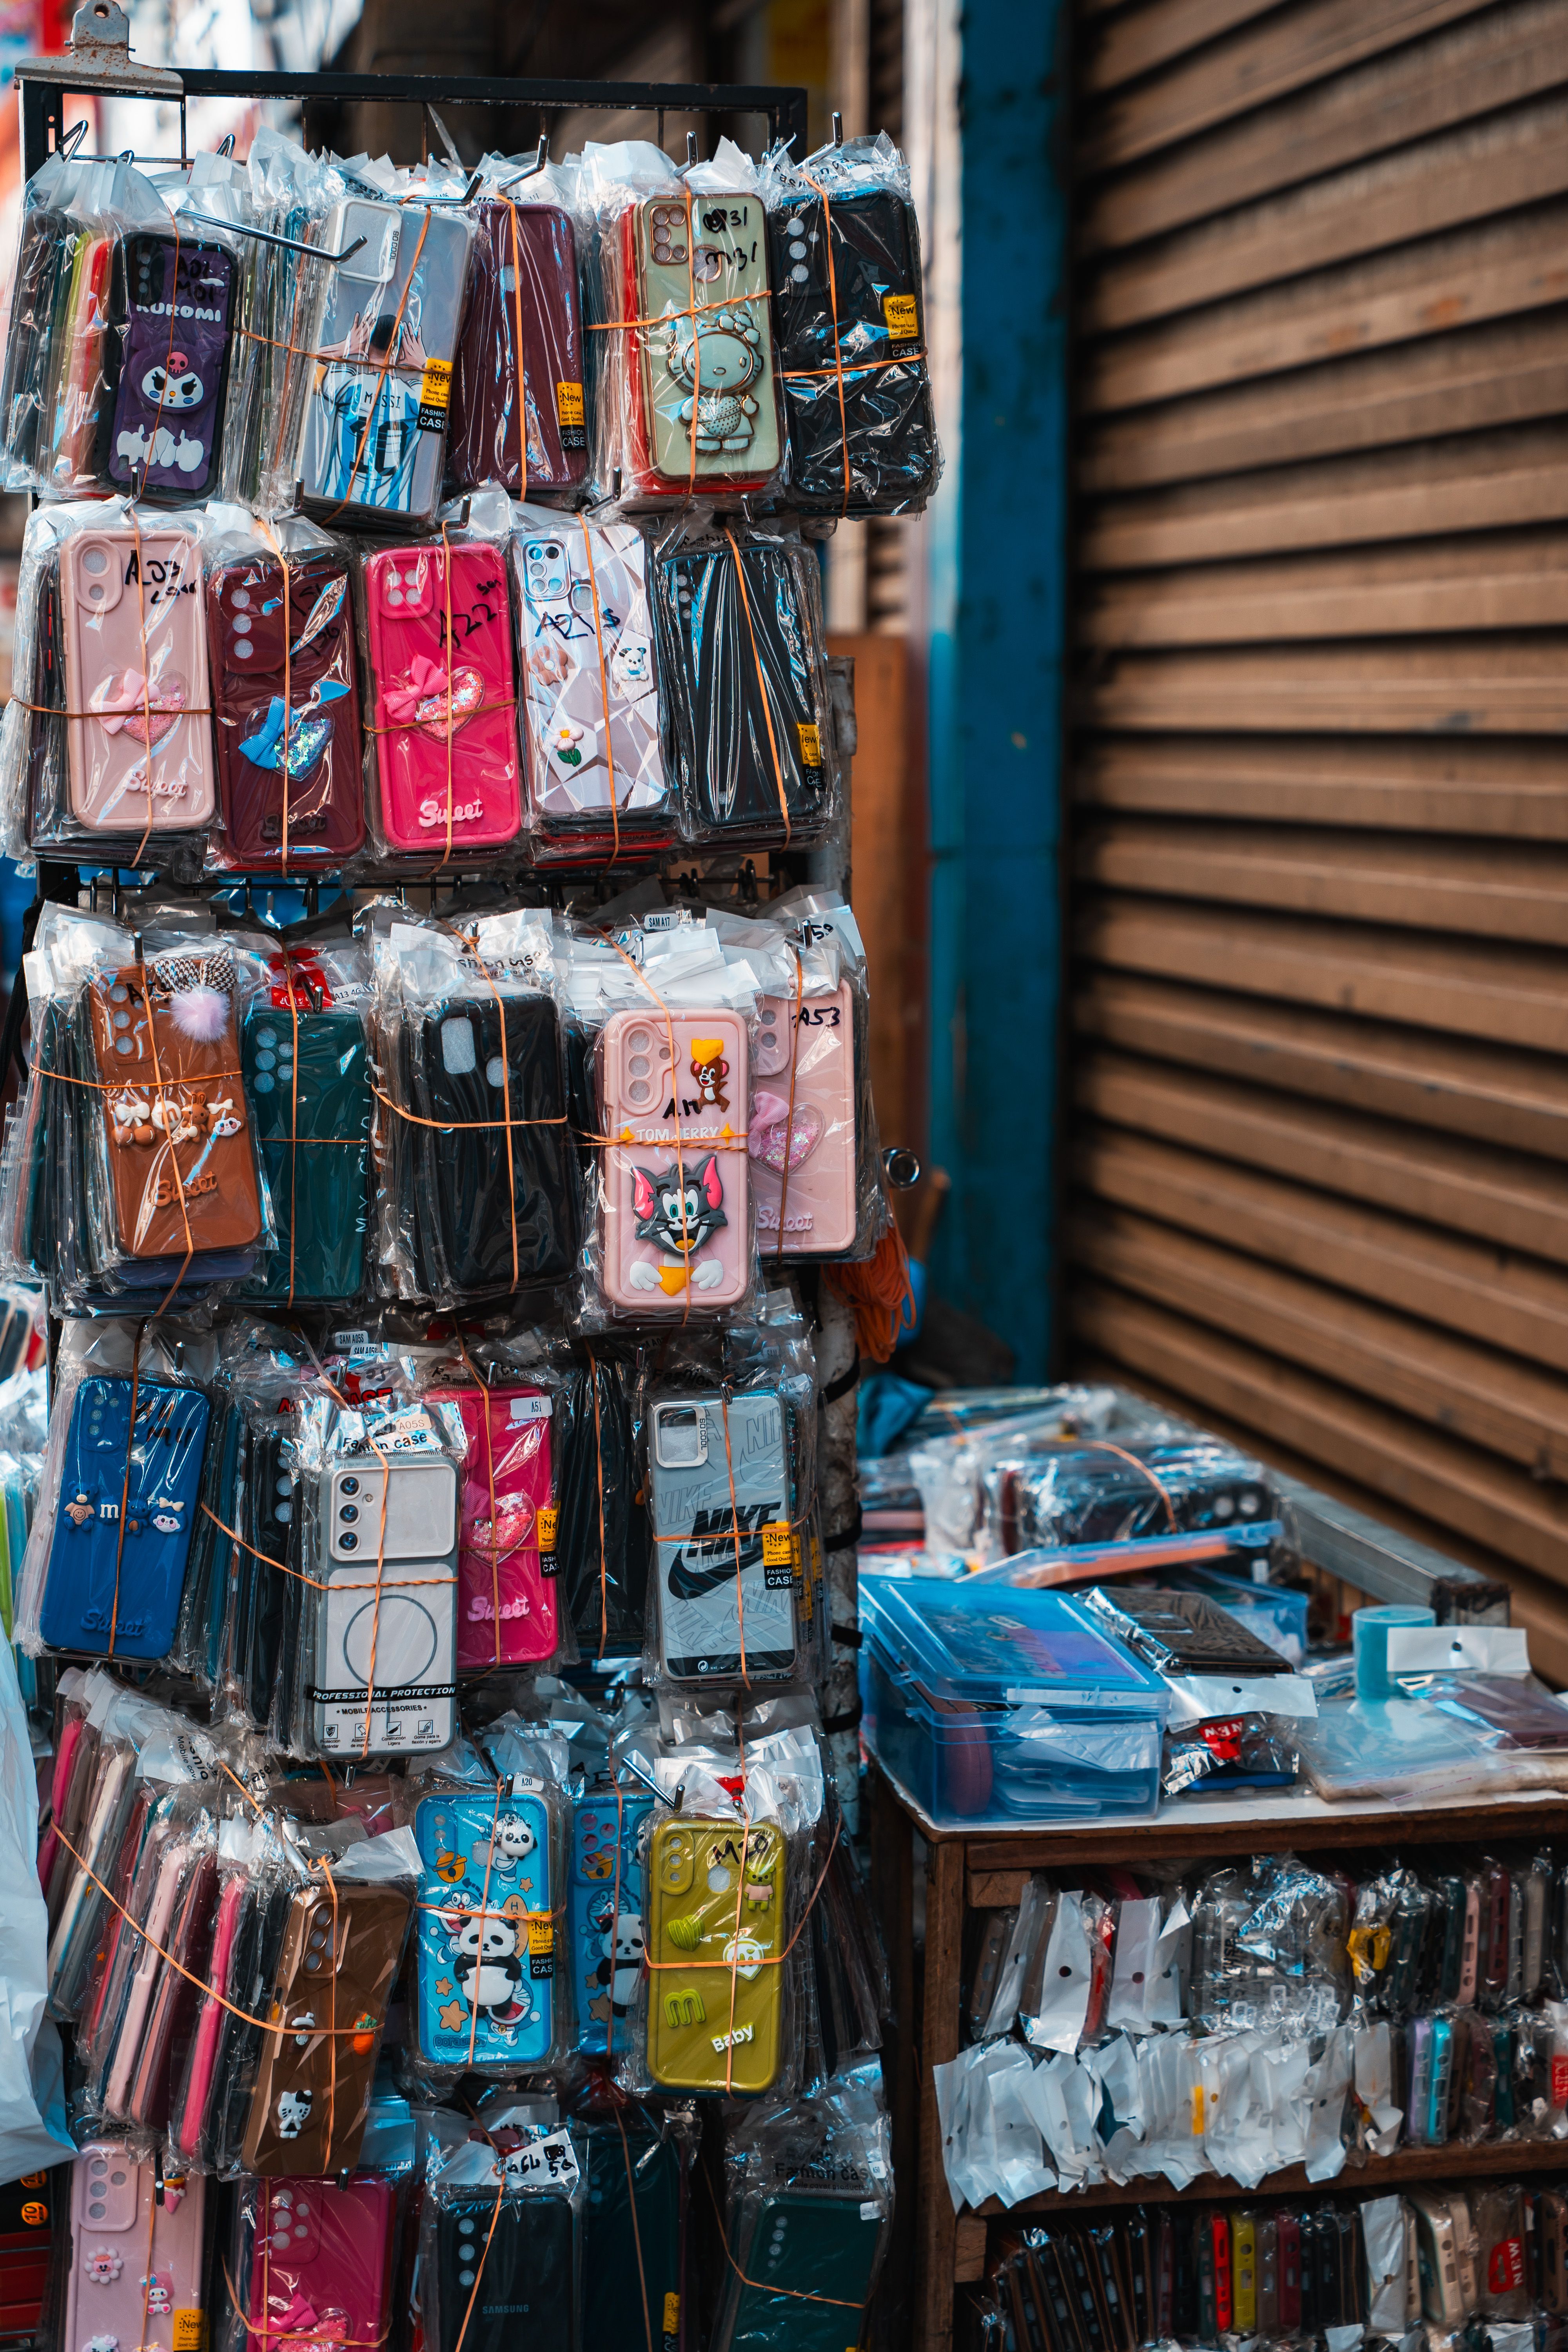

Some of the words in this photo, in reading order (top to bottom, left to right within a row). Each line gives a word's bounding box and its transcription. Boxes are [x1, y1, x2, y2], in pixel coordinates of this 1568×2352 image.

[389, 242, 398, 262] COOL
[891, 306, 914, 315] New
[893, 348, 919, 357] CASE
[364, 391, 401, 409] MSSI
[562, 392, 581, 402] New
[563, 437, 585, 446] CASE
[439, 603, 498, 649] A22
[418, 800, 483, 828] Sweet
[649, 918, 661, 927] SAM
[661, 917, 670, 927] A17
[335, 991, 349, 1000] A13
[791, 1004, 840, 1028] A53
[636, 1128, 670, 1142] TOM
[757, 1206, 813, 1232] Sweet
[339, 1335, 351, 1344] SAM
[352, 1334, 364, 1343] A05S
[531, 1401, 541, 1413] A51
[399, 1419, 425, 1430] A05S
[699, 1418, 706, 1432] SO
[394, 1433, 427, 1449] case
[100, 1503, 119, 1518] m
[769, 1533, 791, 1543] New
[467, 1595, 530, 1622] Sweet
[81, 1608, 146, 1637] Sweet
[390, 1687, 456, 1697] PROTECTION
[371, 1705, 422, 1713] ACCESSORIES
[177, 1736, 189, 1763] Mobile
[521, 1778, 532, 1786] A20
[710, 2023, 754, 2053] Baby
[24, 2206, 37, 2220] 10
[1508, 2242, 1523, 2285] NEW
[482, 2304, 530, 2314] SAMSUNG
